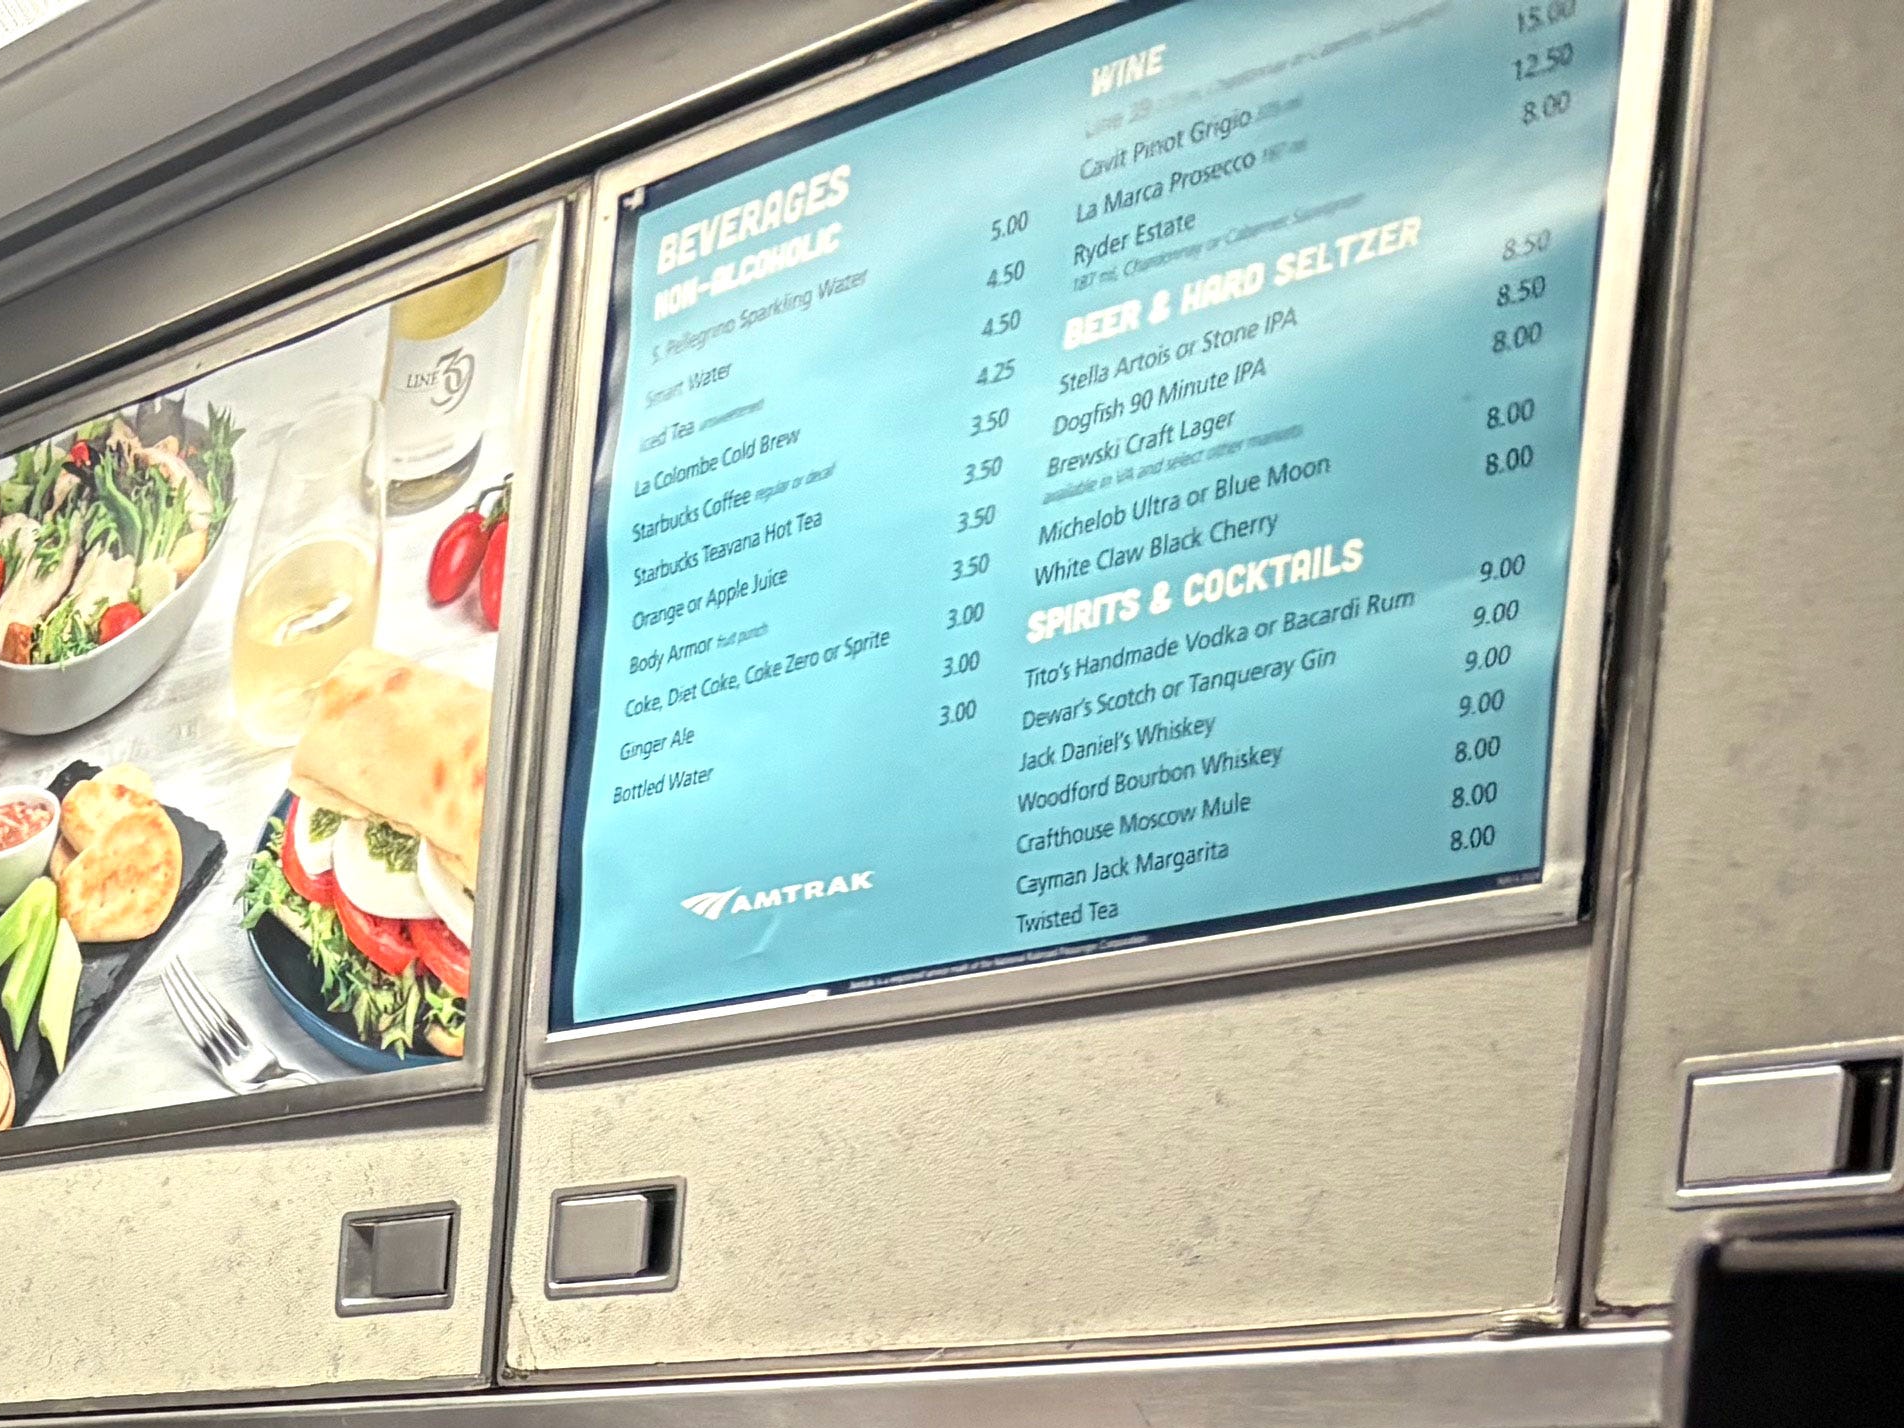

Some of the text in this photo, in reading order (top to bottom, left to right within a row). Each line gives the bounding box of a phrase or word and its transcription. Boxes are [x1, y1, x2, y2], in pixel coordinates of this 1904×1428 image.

[1091, 43, 1166, 98] WINE
[1513, 42, 1574, 81] 12.50
[1523, 90, 1571, 126] 8.00
[1075, 149, 1256, 223] La Marca Prosecco
[657, 164, 851, 275] BEVERAGES
[991, 210, 1029, 242] 5.00
[1502, 227, 1552, 262] 8.50
[654, 222, 845, 321] NON-ALCOHOLIC
[985, 259, 1026, 289] 4.50
[1063, 300, 1141, 351] BEER
[1148, 290, 1171, 325] &
[1180, 263, 1265, 316] HARD
[1274, 216, 1422, 287] SELTZER
[1496, 275, 1547, 308] 8.50
[981, 309, 1022, 337] 4.50
[1492, 320, 1543, 354] 8.00
[406, 371, 438, 388] LINE
[975, 358, 1016, 387] 4.25
[1053, 357, 1268, 437] Dogfish 90 Minute IPA
[970, 407, 1009, 437] 3.50
[1486, 398, 1536, 431] 8.00
[962, 455, 1003, 486] 3.50
[1484, 444, 1534, 477] 8.00
[1038, 455, 1332, 547] Michelob Ultra or Blue Moon
[957, 504, 997, 534] 3.50
[1033, 512, 1280, 588] White Claw Black Cherry
[950, 553, 991, 582] 3.50
[1478, 553, 1527, 583] 9.00
[1026, 537, 1366, 645] SPIRITS & COCKTAILS
[946, 601, 986, 631] 3.00
[1472, 599, 1520, 629] 9.00
[1024, 589, 1417, 690] Tito's Handmade Vodka or Bacardi Rum
[941, 650, 980, 679] 3.00
[1463, 645, 1511, 673] 9.00
[1021, 646, 1337, 731] Dewar's Scotch or Tanqueray Gin
[1458, 690, 1505, 717] 9.00
[938, 699, 977, 727] 3.00
[619, 727, 695, 763] Ginger Ale
[1018, 715, 1216, 773] Jack Daniel's Whiskey
[1454, 736, 1501, 763] 8.00
[612, 766, 714, 805] Bottled Water
[1016, 742, 1283, 813] Woodford Bourbon Whiskey
[1451, 782, 1498, 809] 8.00
[1016, 792, 1252, 854] Crafthouse Moscow Mule
[1450, 825, 1495, 852] 8.00
[1016, 840, 1230, 895] Cayman Jack Margarita
[730, 870, 876, 914] AMTRAK
[1016, 901, 1119, 933] Twisted Tea
